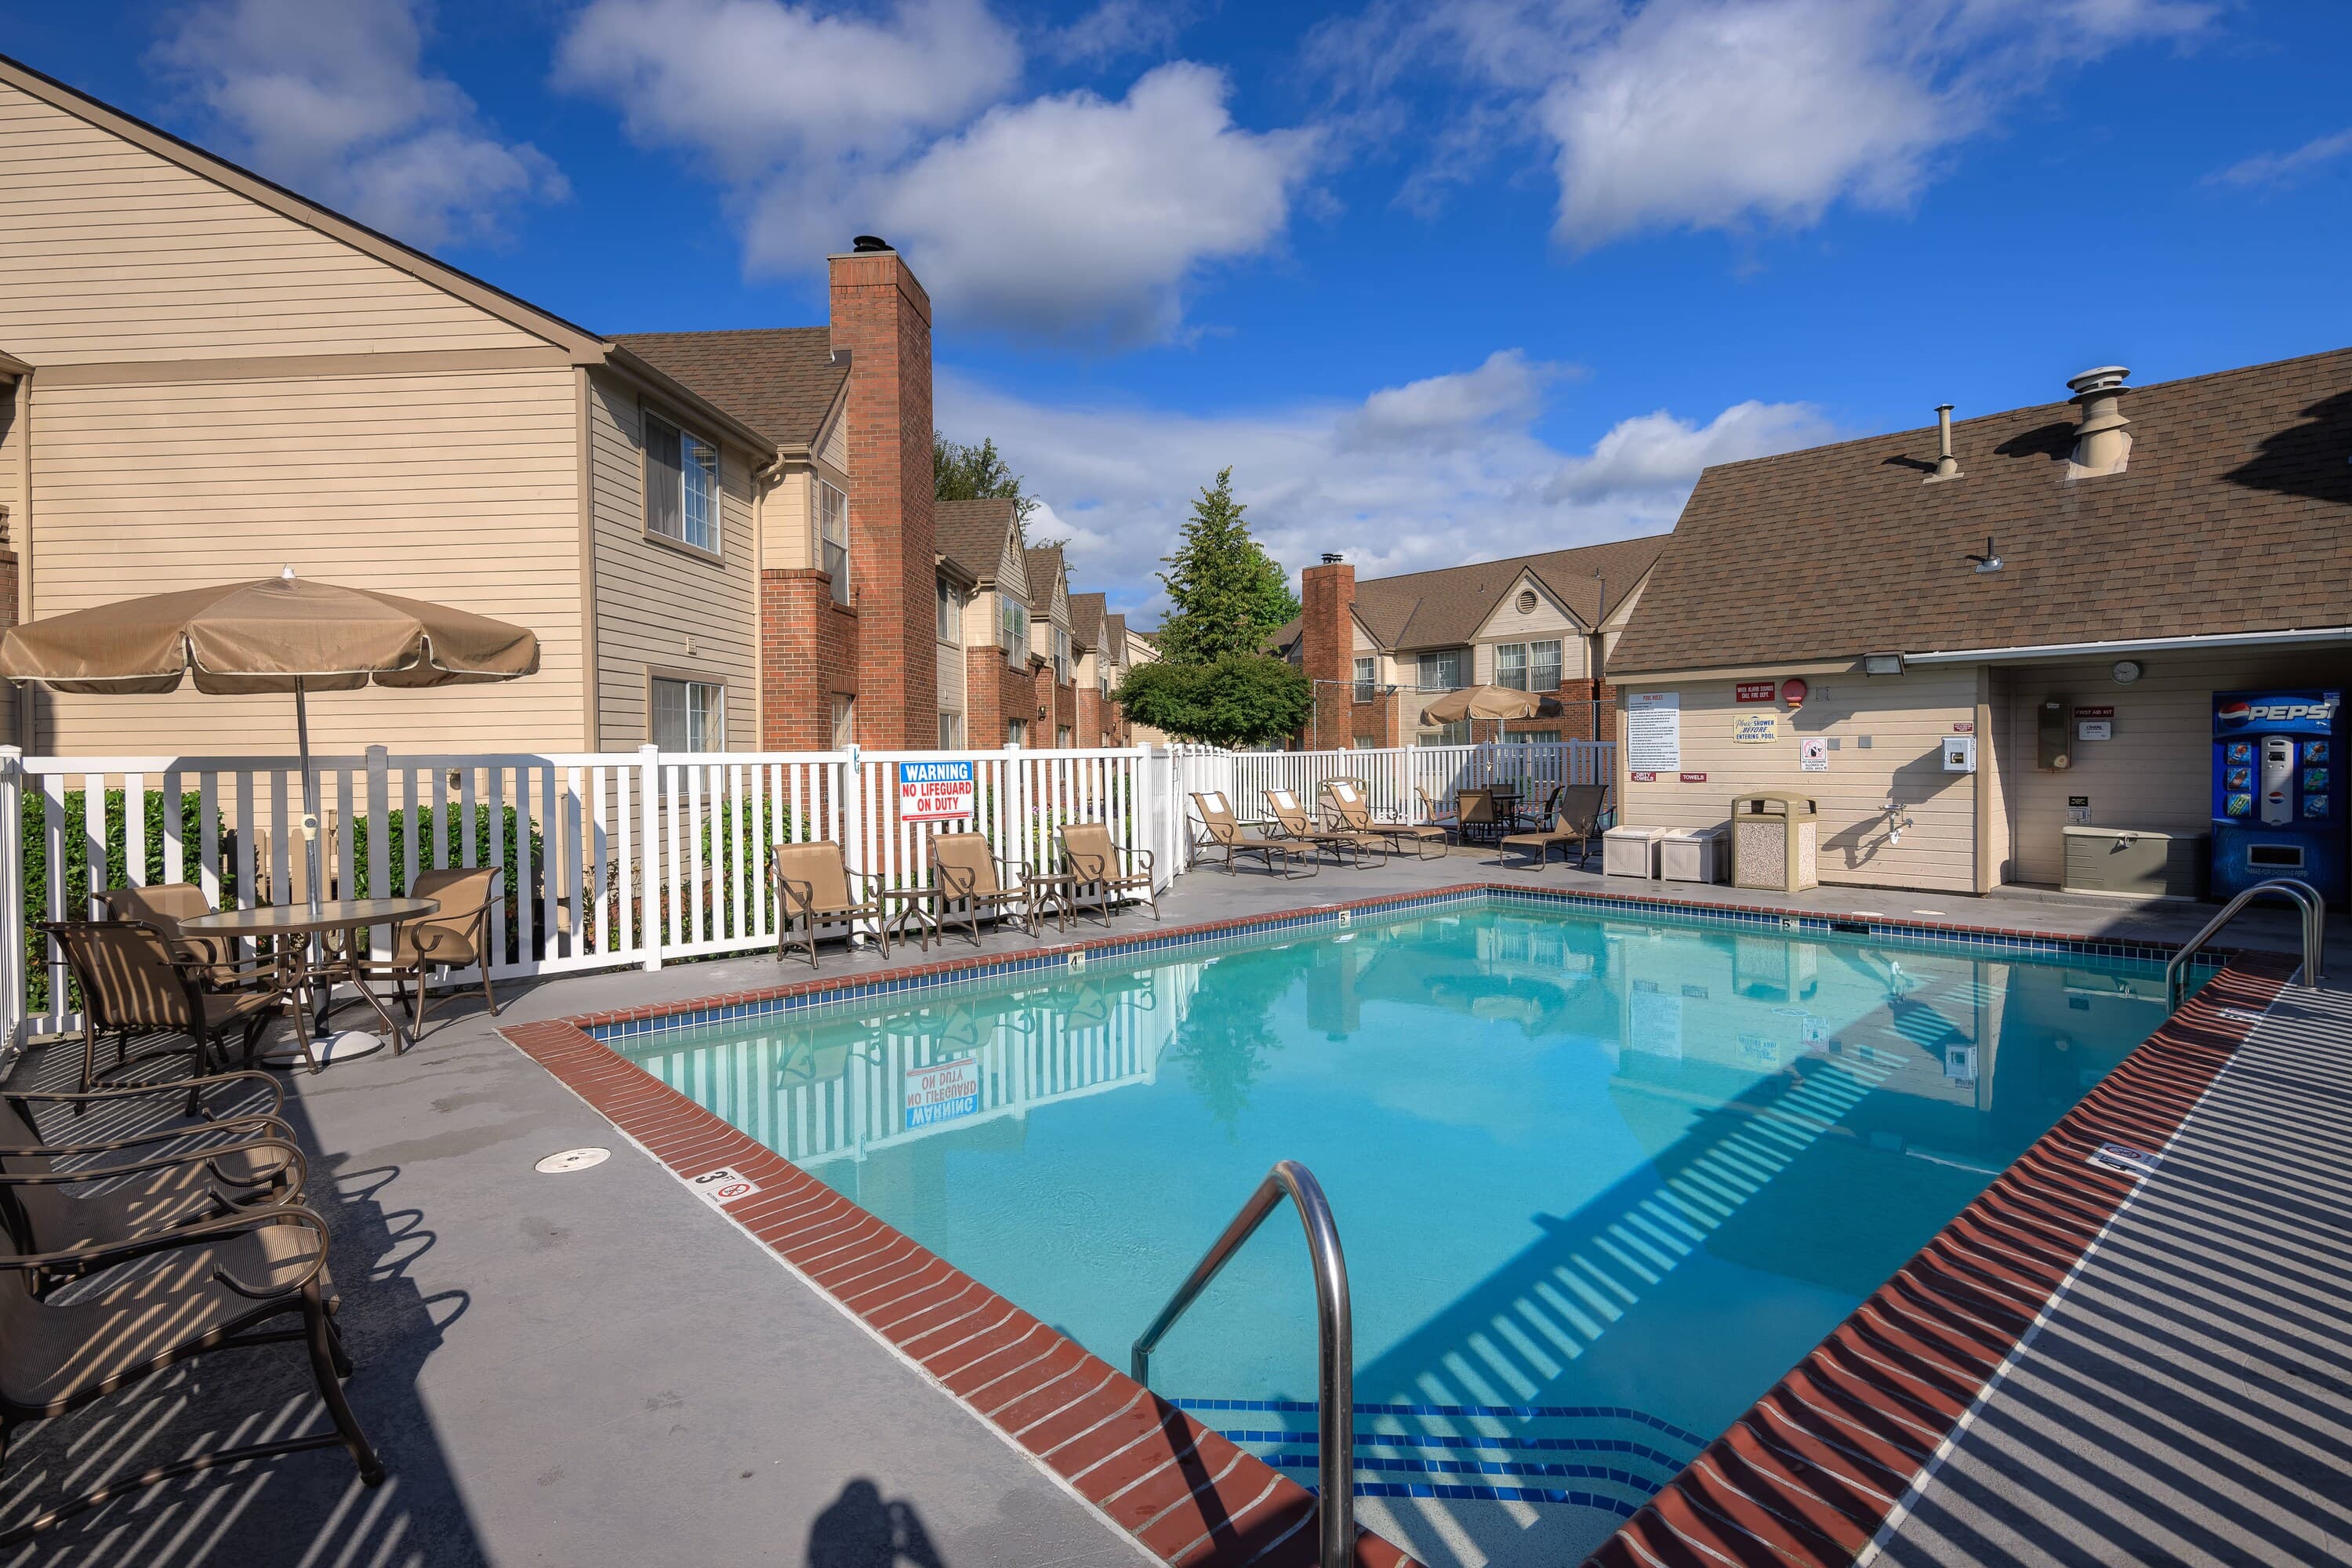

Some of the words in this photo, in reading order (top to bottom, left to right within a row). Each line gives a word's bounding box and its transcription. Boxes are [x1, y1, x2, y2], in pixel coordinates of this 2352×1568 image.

[2248, 705, 2336, 720] PEPSI
[906, 764, 968, 781] WARNING
[902, 783, 916, 797] NO
[920, 782, 971, 797] LIFEGUARD
[917, 798, 931, 811] ON
[935, 797, 959, 811] DUTY
[695, 1171, 728, 1184] 3
